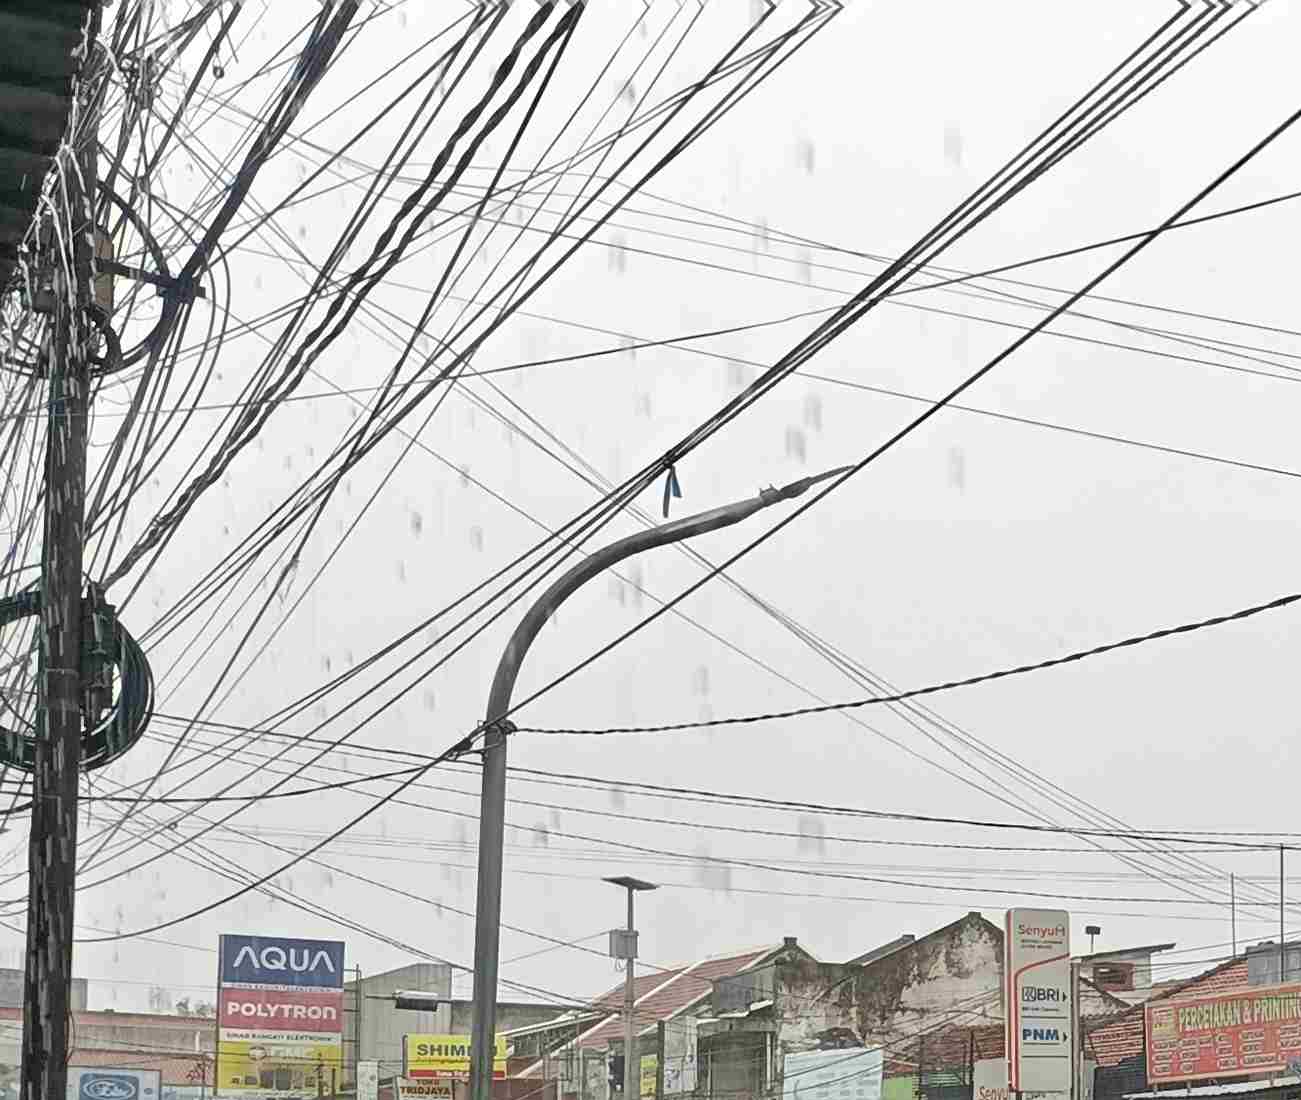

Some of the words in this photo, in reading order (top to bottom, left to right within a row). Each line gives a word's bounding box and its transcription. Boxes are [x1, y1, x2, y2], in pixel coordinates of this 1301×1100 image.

[232, 945, 336, 974] AQUA
[1036, 987, 1060, 1001] BRI
[1021, 1028, 1060, 1041] PNM
